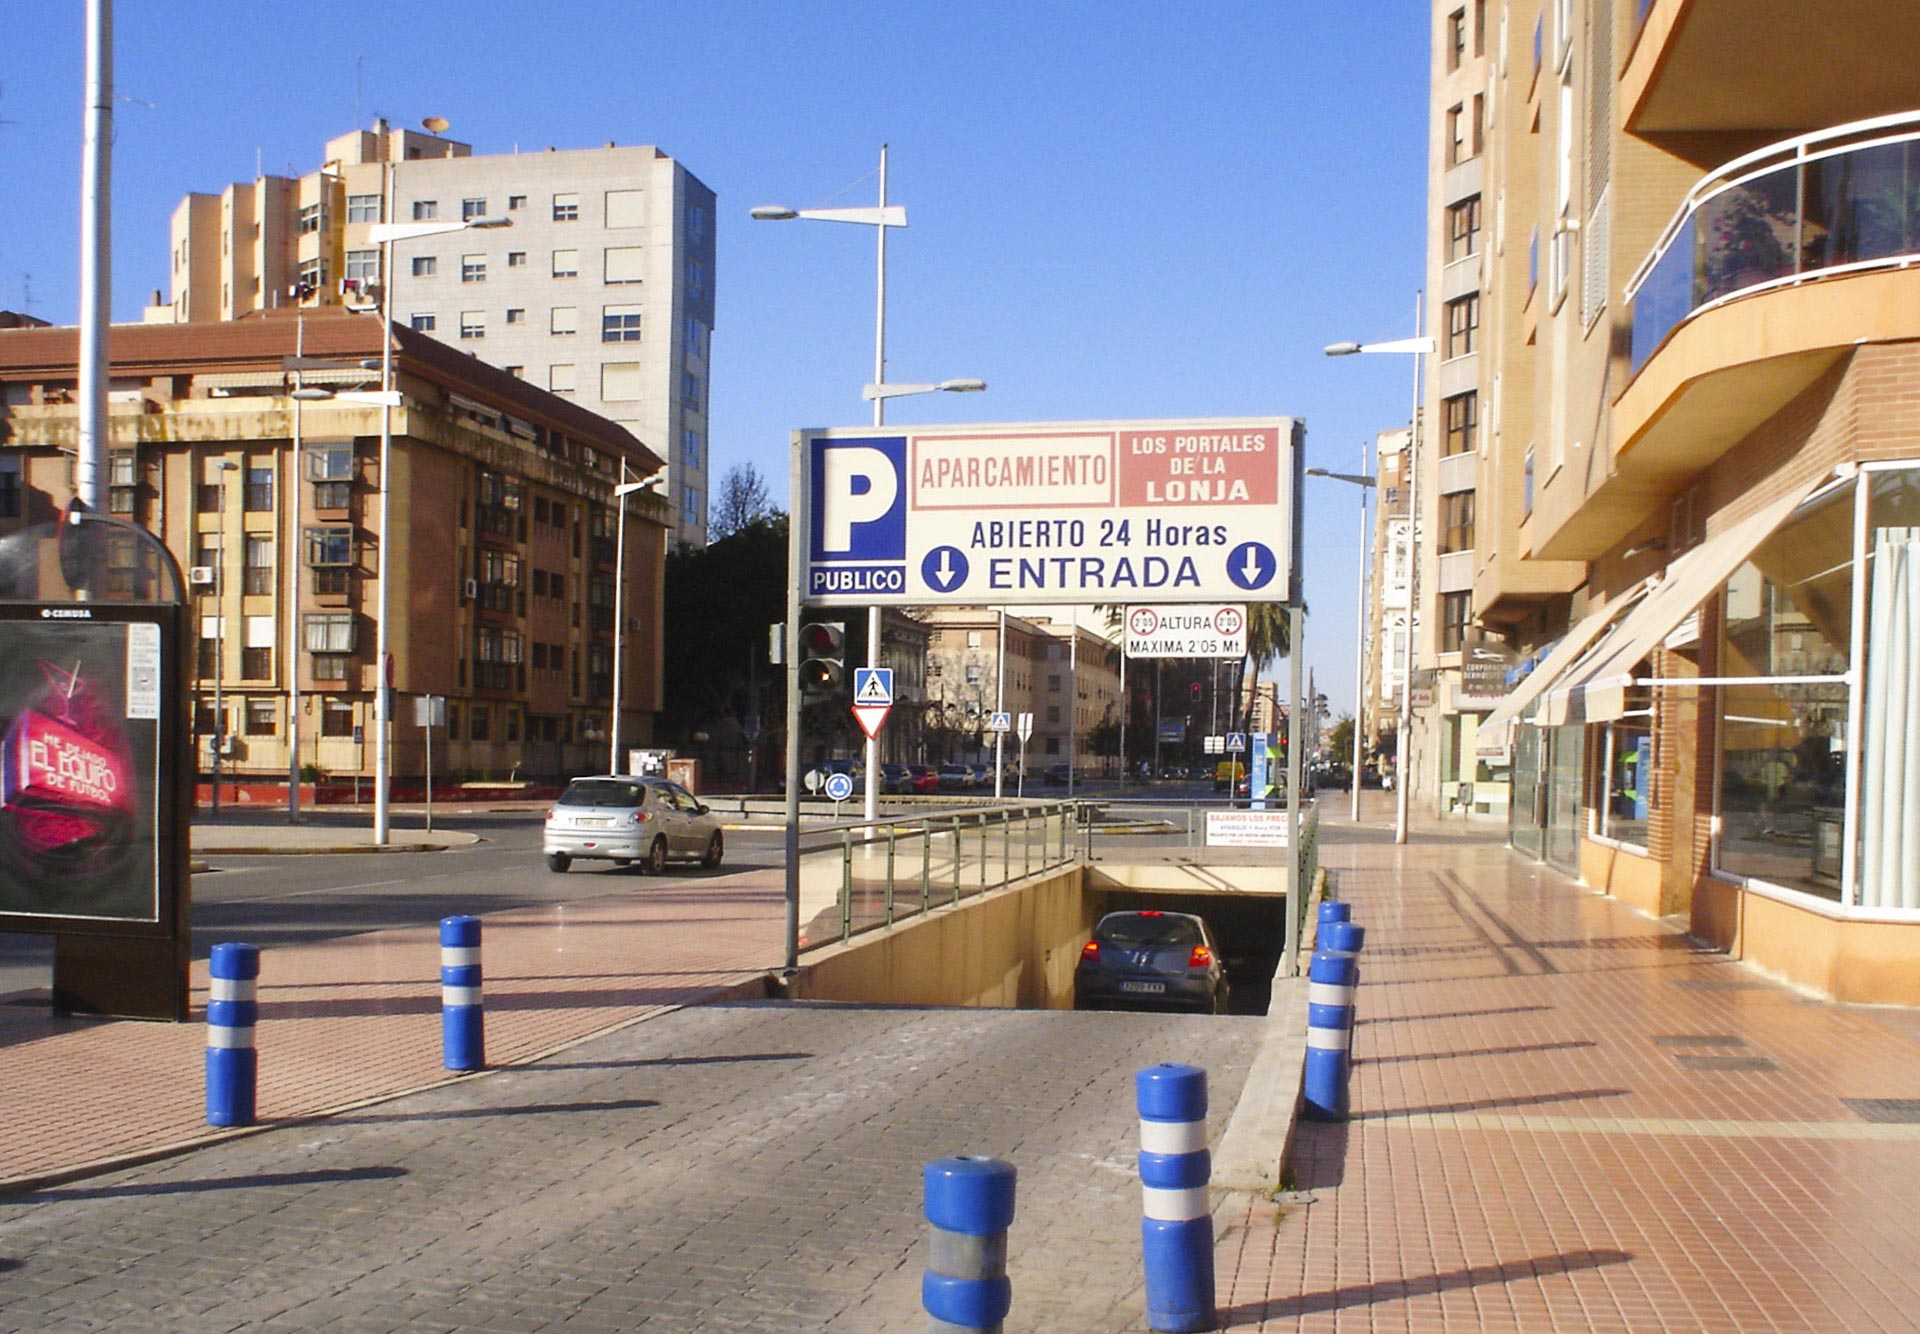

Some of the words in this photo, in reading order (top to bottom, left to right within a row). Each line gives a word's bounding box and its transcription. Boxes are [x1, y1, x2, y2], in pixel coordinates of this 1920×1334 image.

[1132, 437, 1166, 454] LOS
[1175, 434, 1265, 453] PORTALES
[921, 455, 1106, 488] APARCAMIENTO
[1170, 457, 1194, 475] DE
[1203, 457, 1226, 474] LA
[824, 447, 897, 552] P
[1146, 479, 1249, 502] LONJA
[971, 520, 1084, 548] ABIERTO
[1100, 519, 1131, 546] 24
[1147, 518, 1227, 546] Horas
[814, 570, 902, 590] PUBLICO
[989, 556, 1201, 589] ENTRADA
[1160, 616, 1211, 629] ALTURA
[1130, 640, 1184, 653] MAXIMA
[1188, 640, 1217, 653] 2'05
[30, 739, 55, 772] EL
[58, 751, 116, 791] EQUIPO
[46, 773, 65, 788] DE
[70, 780, 111, 802] FUTBOL
[1249, 814, 1264, 822] LOS
